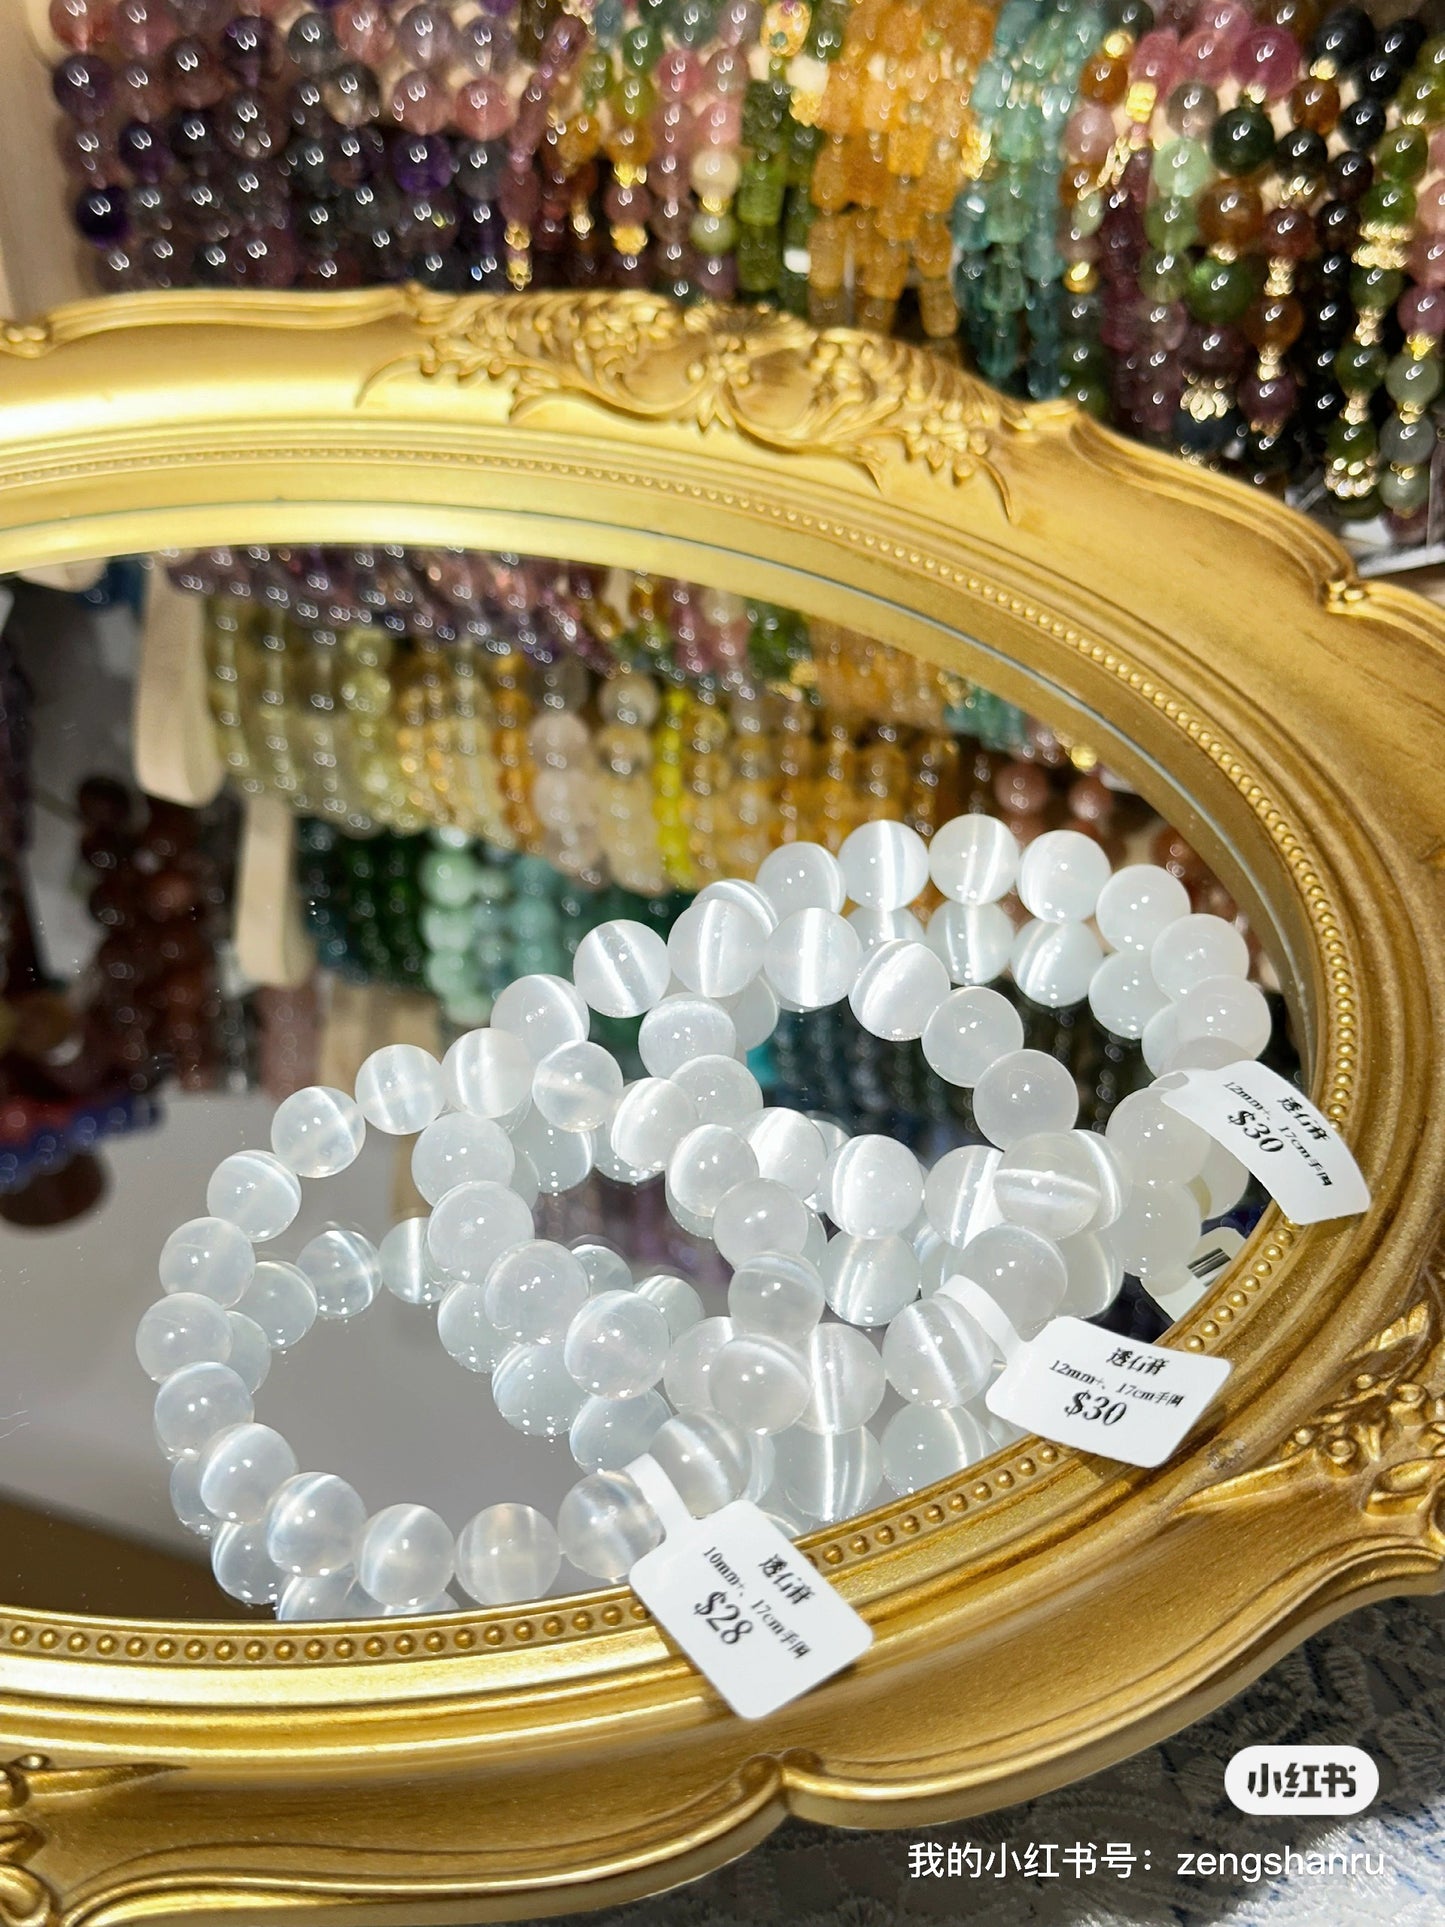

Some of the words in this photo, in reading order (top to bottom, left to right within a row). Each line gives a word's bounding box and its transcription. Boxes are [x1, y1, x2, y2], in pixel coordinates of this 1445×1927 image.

[1227, 1110, 1284, 1153] $30
[1064, 1389, 1127, 1426] $30
[693, 1590, 754, 1645] $28
